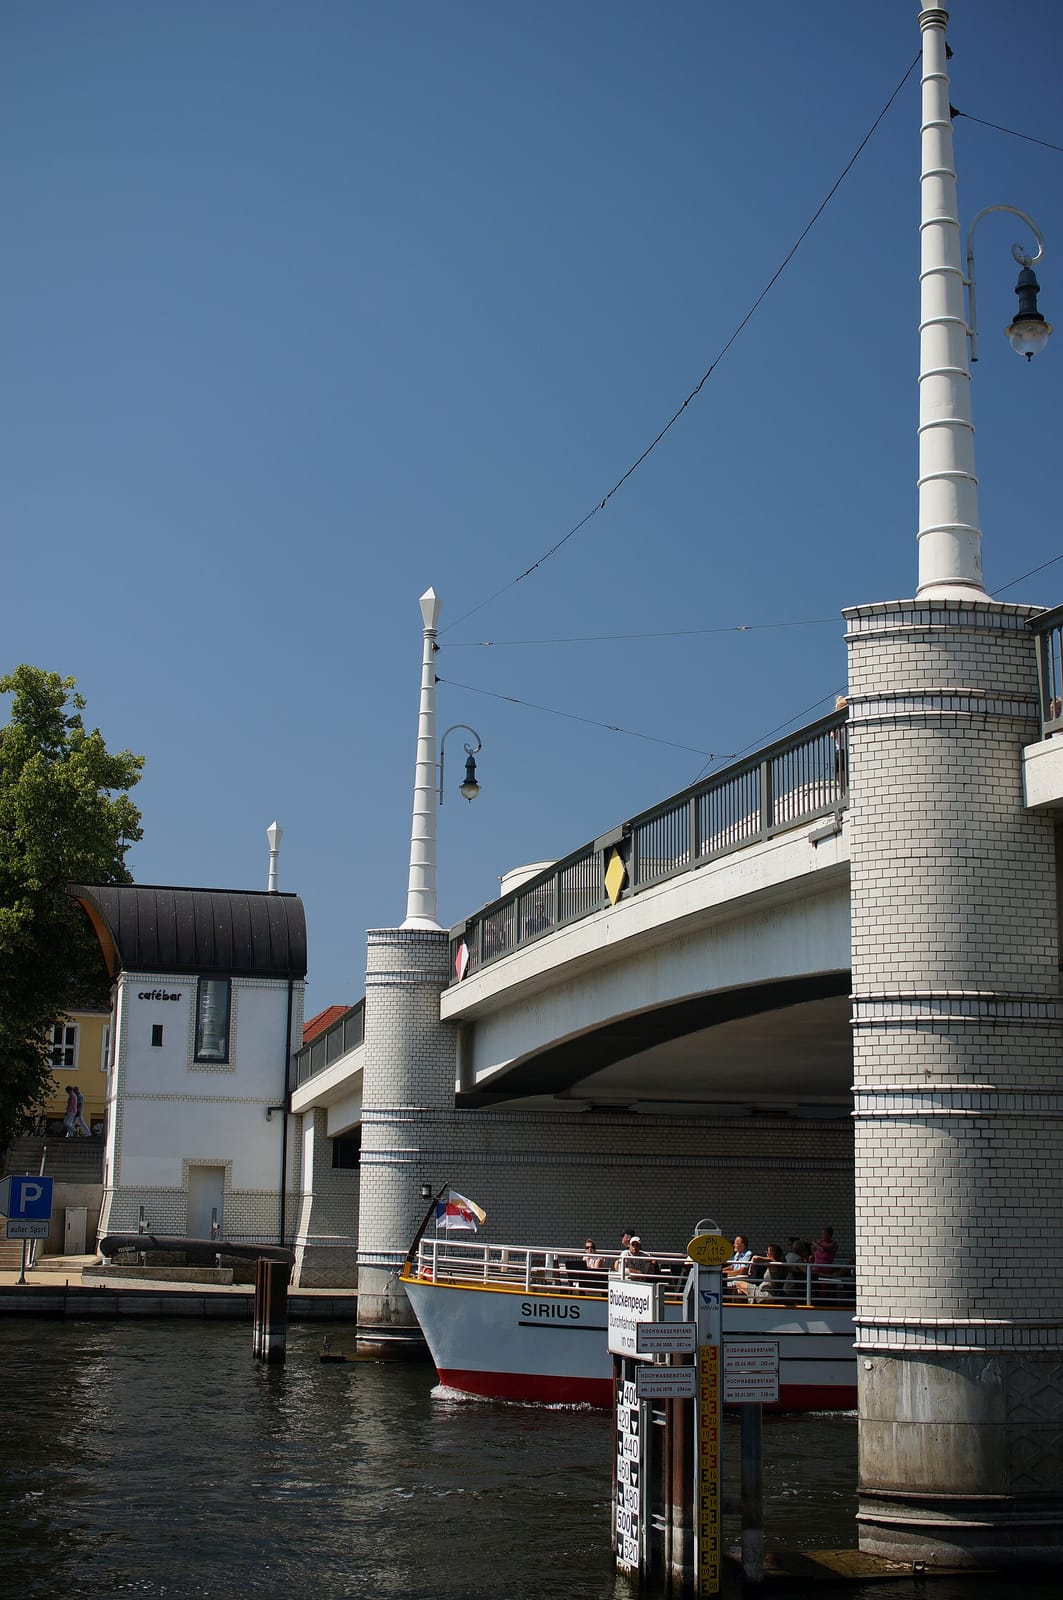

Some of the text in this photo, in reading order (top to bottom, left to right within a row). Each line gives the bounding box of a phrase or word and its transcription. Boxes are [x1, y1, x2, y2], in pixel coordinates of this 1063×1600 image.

[138, 989, 182, 1001] cafébar
[20, 1183, 42, 1212] P
[521, 1302, 580, 1319] SIRIUS
[609, 1289, 650, 1314] Brückenpegel
[624, 1386, 639, 1406] 400
[618, 1409, 630, 1430] 420
[624, 1438, 639, 1458] 440
[625, 1488, 638, 1510] 480
[617, 1510, 631, 1533] 500
[624, 1539, 637, 1563] 520
